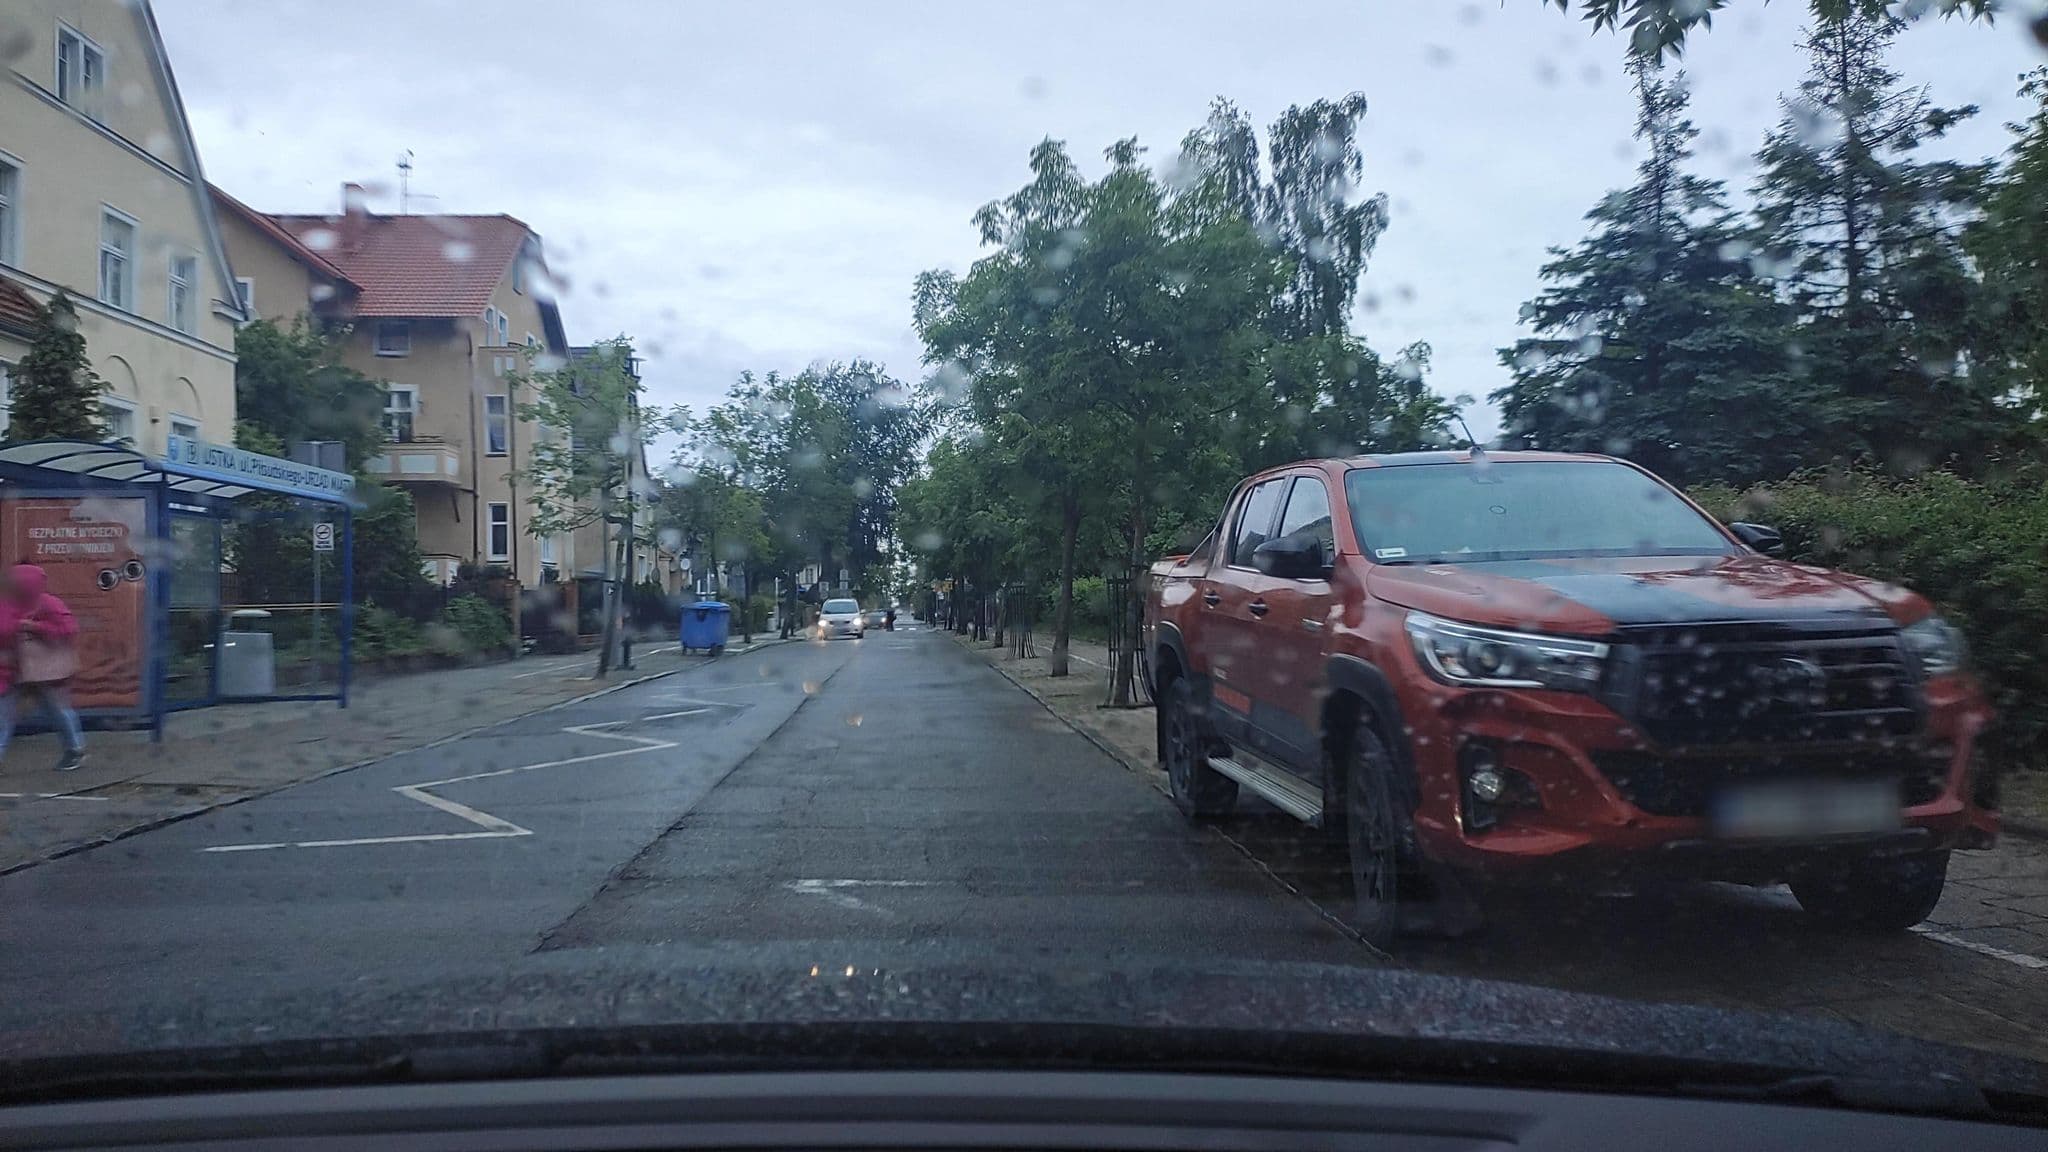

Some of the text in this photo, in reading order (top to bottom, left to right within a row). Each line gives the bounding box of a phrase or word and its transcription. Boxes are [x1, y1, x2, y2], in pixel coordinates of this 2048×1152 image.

[29, 527, 77, 539] BEZPŁATNE
[37, 543, 115, 554] Z PRZEWNIKIEM
